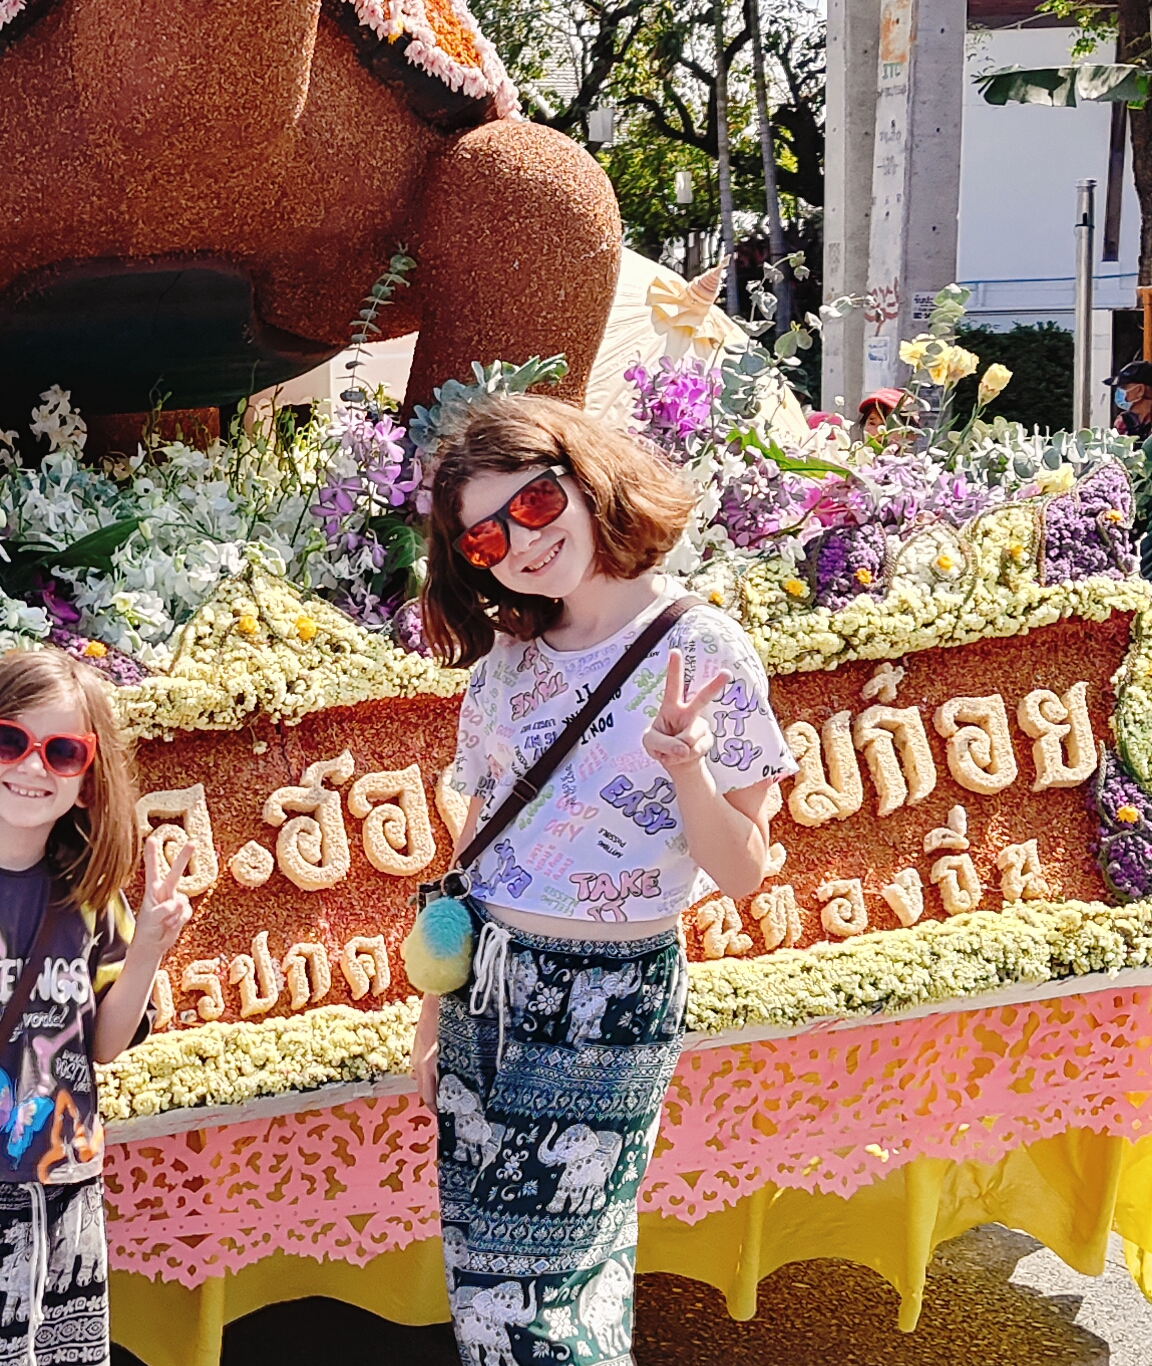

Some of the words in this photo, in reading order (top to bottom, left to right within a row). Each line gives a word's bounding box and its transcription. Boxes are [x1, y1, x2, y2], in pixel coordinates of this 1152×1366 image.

[580, 712, 614, 746] DON'T
[713, 710, 751, 738] IT
[599, 773, 678, 836] EASY
[568, 867, 663, 903] TAKE
